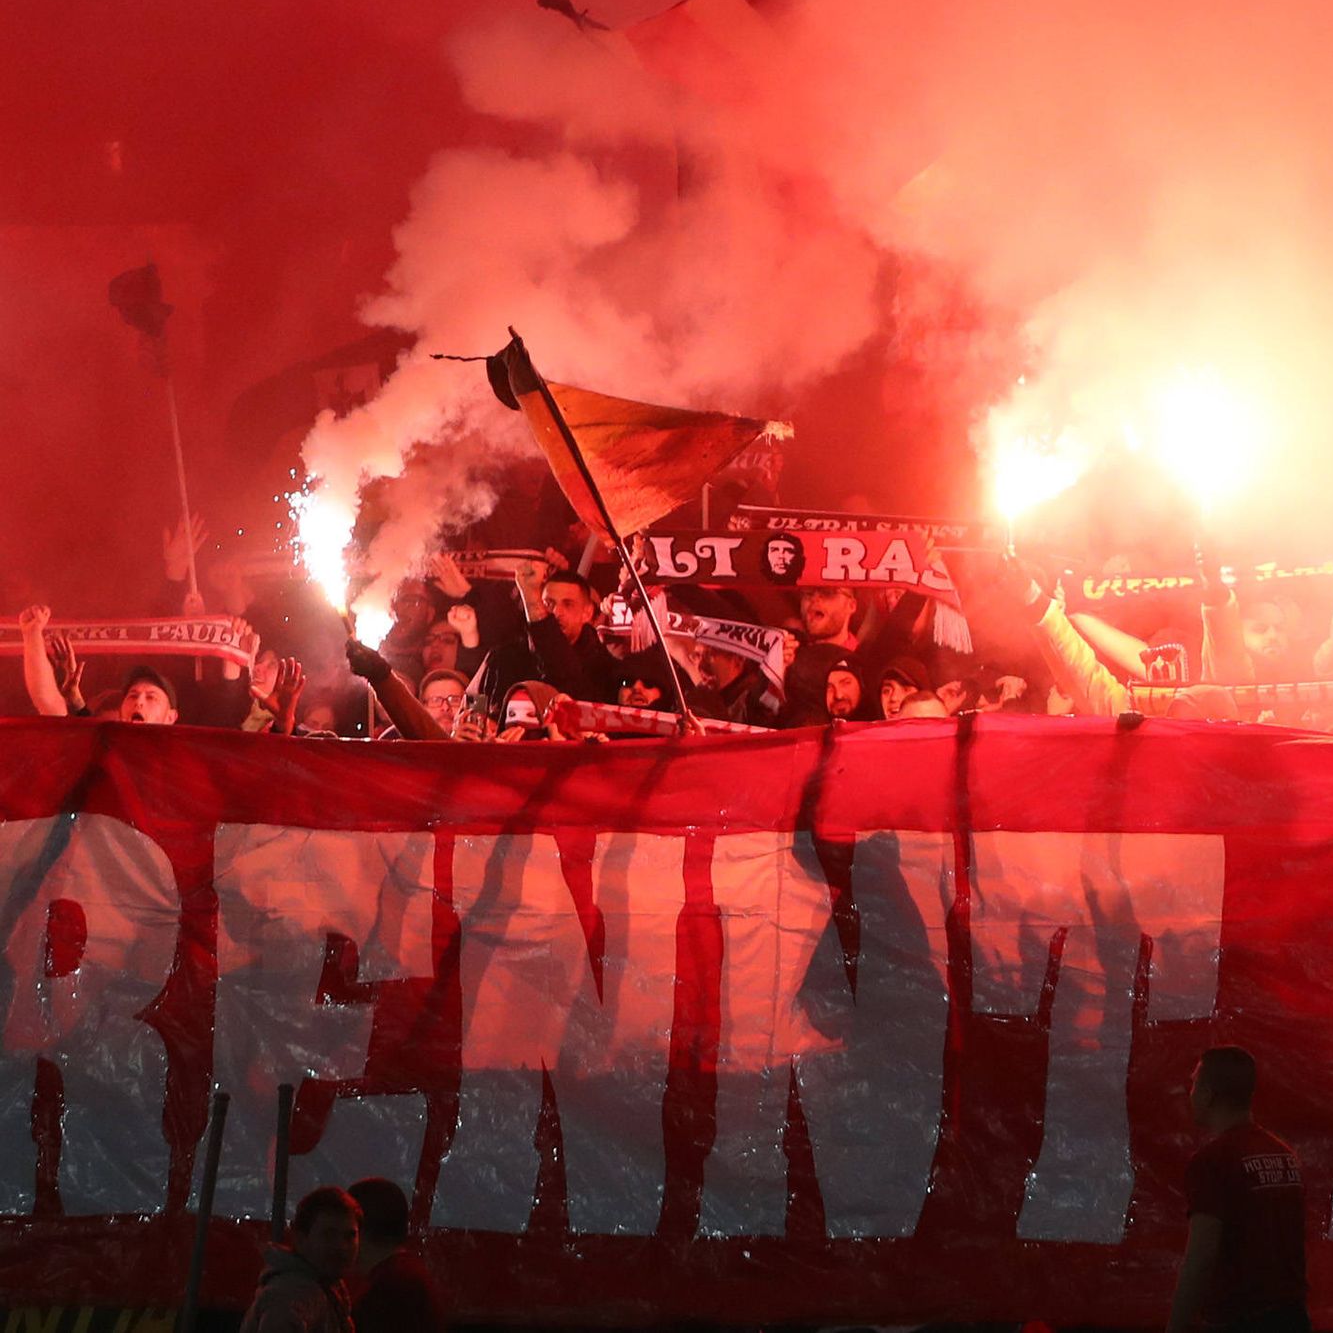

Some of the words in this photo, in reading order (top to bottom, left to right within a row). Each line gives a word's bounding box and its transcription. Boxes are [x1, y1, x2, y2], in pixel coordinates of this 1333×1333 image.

[650, 535, 744, 579] LT
[149, 622, 244, 648] PAULI
[0, 812, 1226, 1246] RENNT
